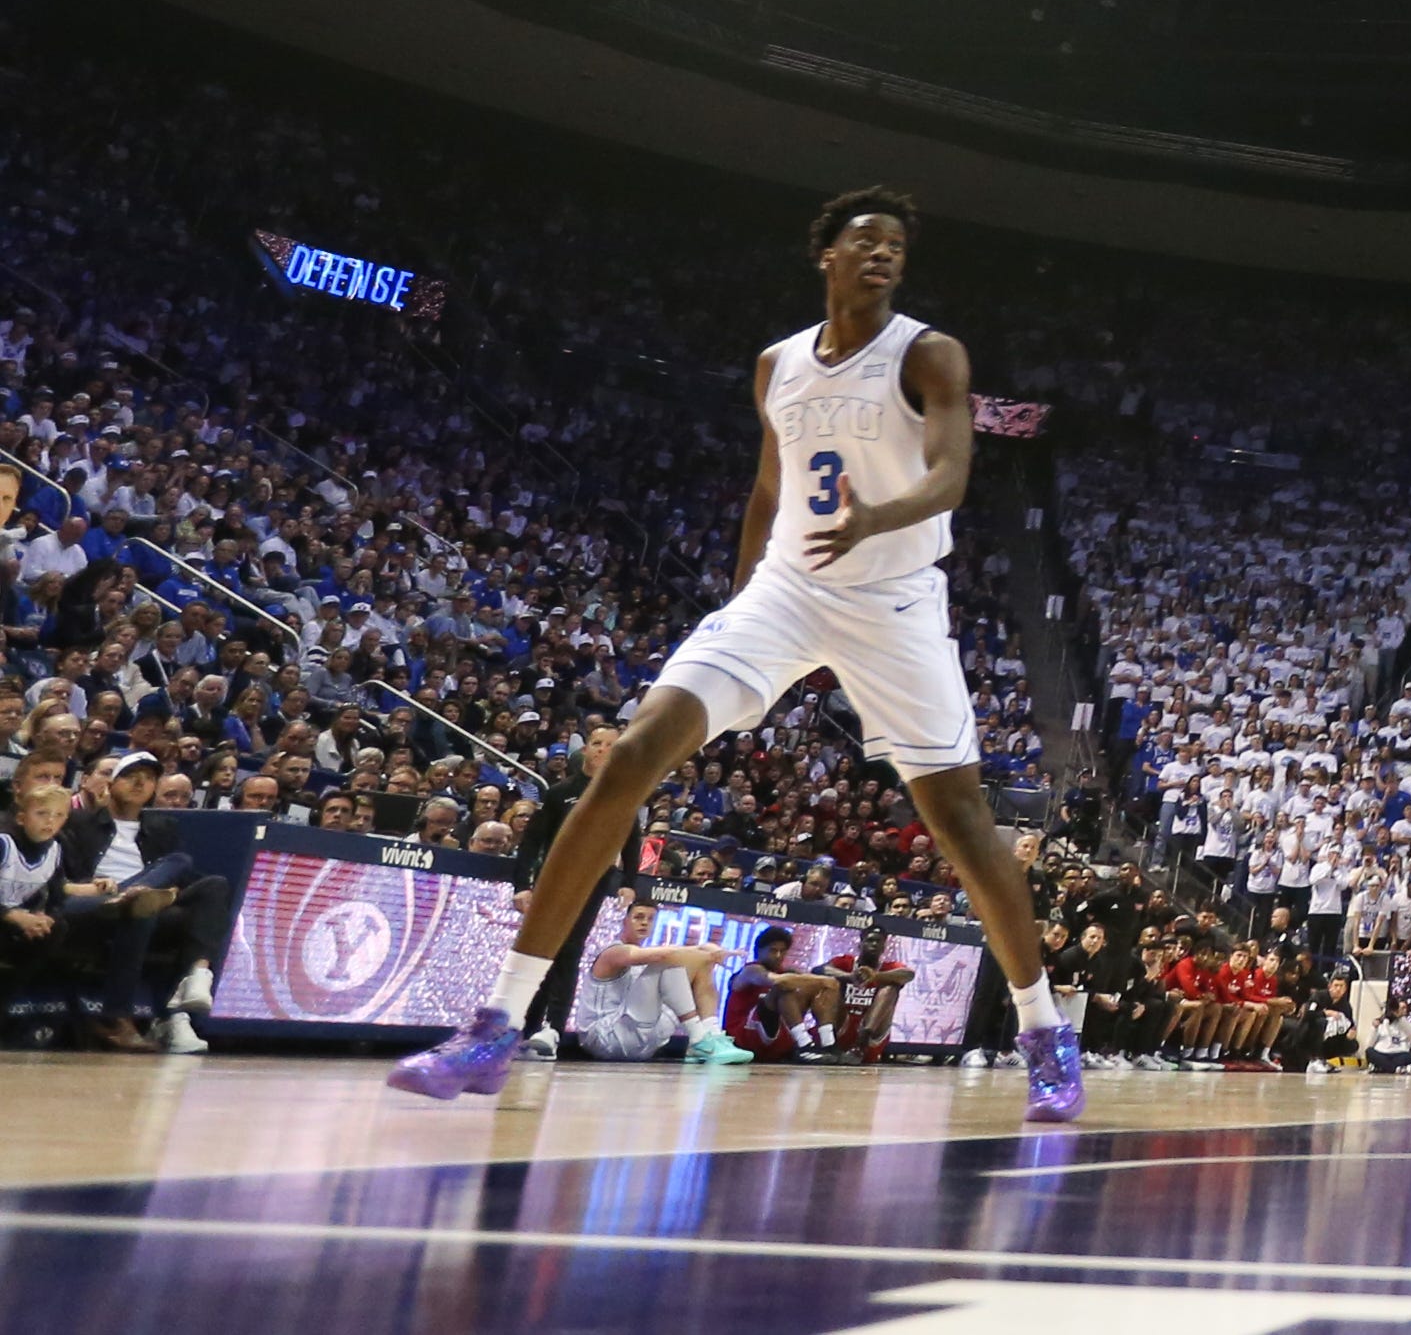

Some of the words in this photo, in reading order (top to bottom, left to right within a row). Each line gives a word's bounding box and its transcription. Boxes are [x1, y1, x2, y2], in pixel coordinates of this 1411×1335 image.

[286, 244, 415, 312] DEFENSE
[774, 395, 885, 448] BYU
[808, 450, 844, 515] 3
[845, 983, 877, 996] TEXAS
[845, 995, 873, 1007] TECH
